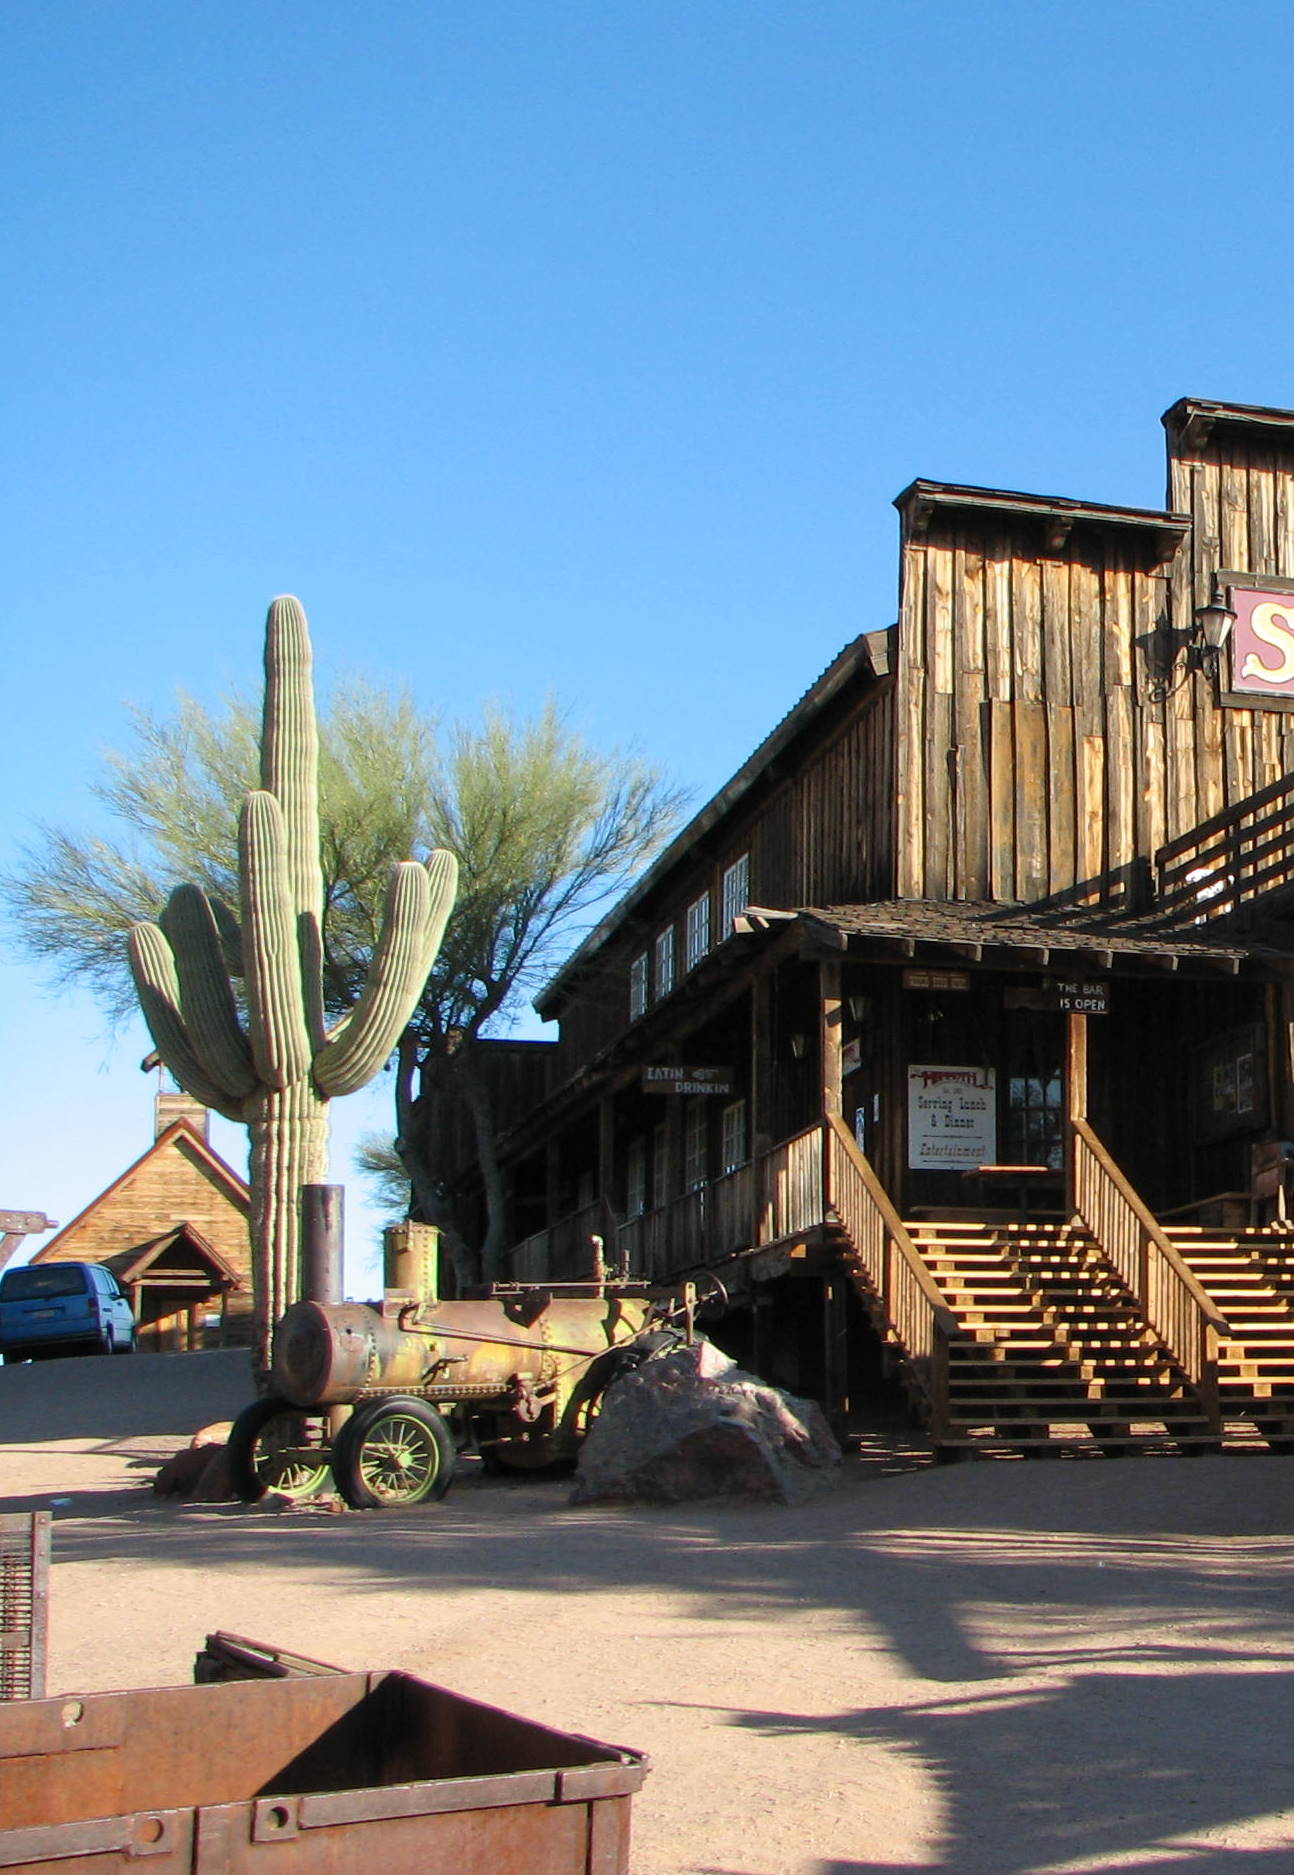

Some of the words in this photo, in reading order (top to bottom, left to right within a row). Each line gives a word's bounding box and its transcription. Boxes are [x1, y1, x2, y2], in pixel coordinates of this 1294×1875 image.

[1057, 983, 1078, 993] THE
[1082, 983, 1104, 995] BAR
[1059, 998, 1071, 1008] IS
[1074, 998, 1106, 1010] OPEN
[647, 1067, 684, 1080] EATIN
[674, 1082, 730, 1094] DRINKIN
